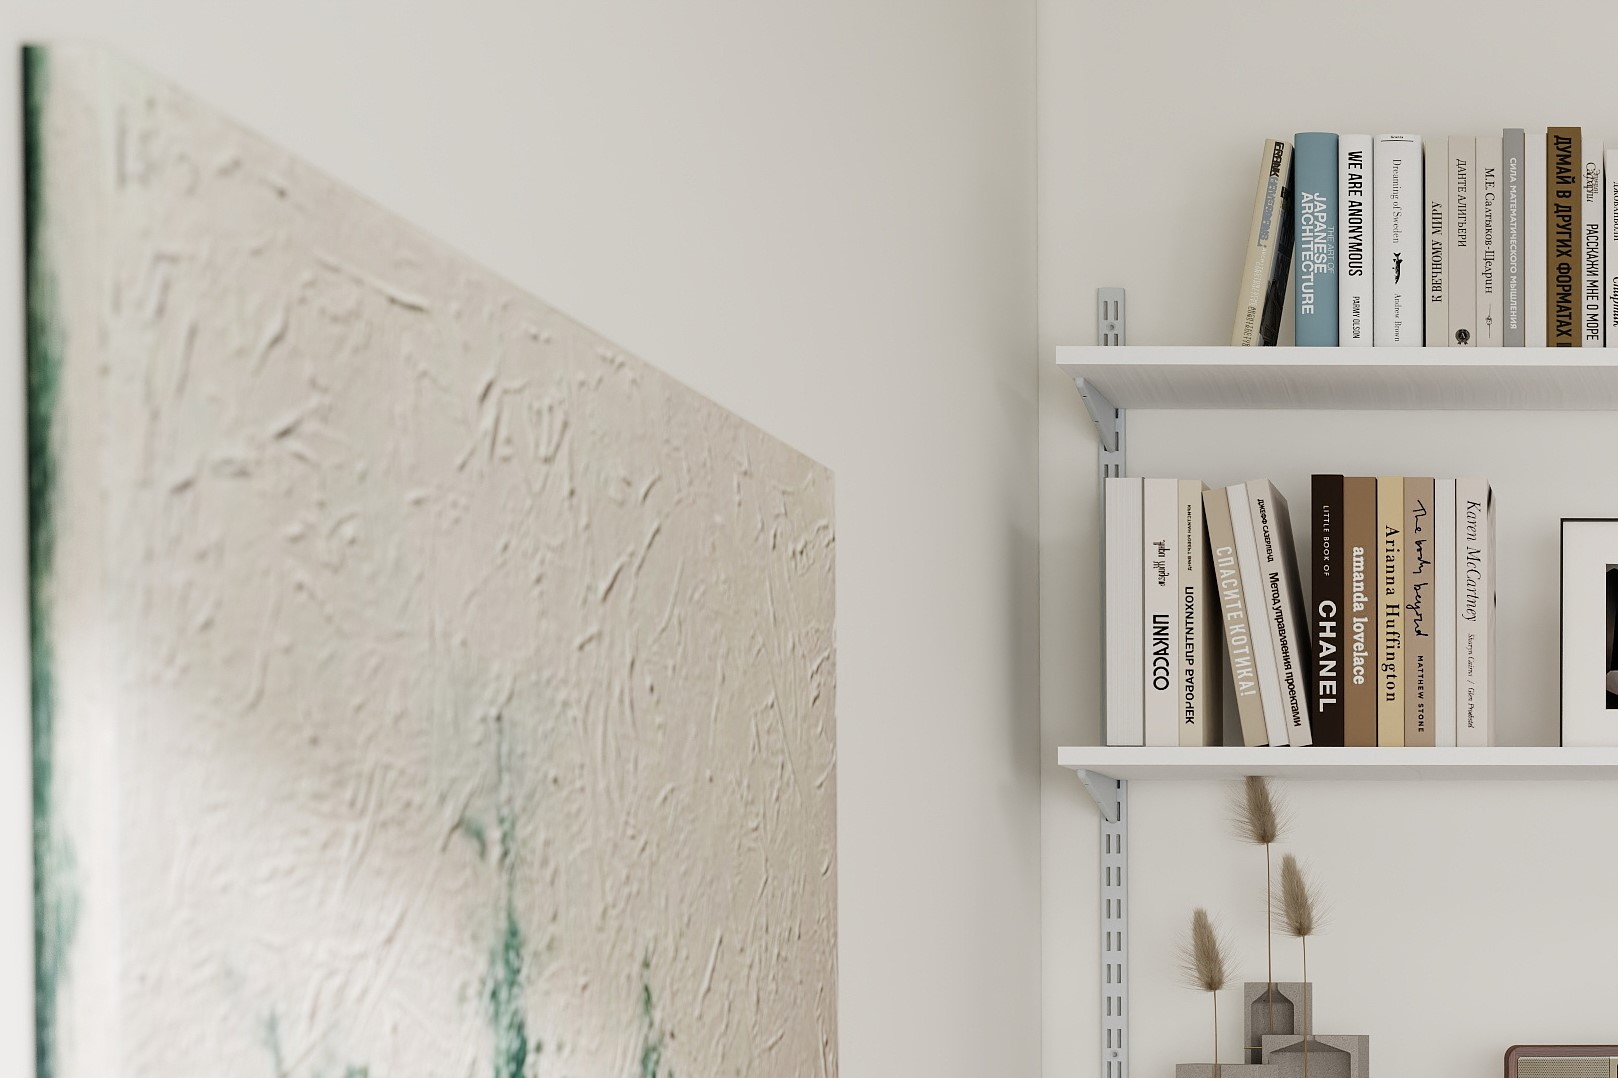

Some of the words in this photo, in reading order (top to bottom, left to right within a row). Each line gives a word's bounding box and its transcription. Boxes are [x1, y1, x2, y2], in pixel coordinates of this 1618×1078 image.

[1348, 151, 1362, 169] WE
[1348, 174, 1362, 196] ARE
[1391, 159, 1402, 199] Dreaming
[1456, 159, 1467, 192] ДАНТЕ
[1485, 168, 1494, 190] М.Е.
[1554, 135, 1575, 185] ДУМАЙ
[1393, 202, 1402, 210] of
[1432, 201, 1442, 235] МИРУ
[1556, 190, 1571, 198] В
[1314, 192, 1326, 274] JAPANESE
[1348, 201, 1362, 277] ANONYMOUS
[1393, 211, 1402, 243] Sweden
[1457, 194, 1467, 247] АЛИГЬЕРИ
[1482, 192, 1495, 293] Салтыков-Щедрин
[1554, 204, 1571, 258] ДРУГИХ
[1301, 192, 1314, 314] ARCHITECTURE
[1328, 264, 1335, 274] OF
[1432, 240, 1442, 292] ВЕЧНОМУ
[1587, 224, 1598, 276] РАССКАЖИ
[1394, 293, 1402, 319] Andrew
[1556, 263, 1572, 337] ФОРМАТАХ
[1587, 280, 1598, 300] МНЕ
[1394, 321, 1402, 341] Brown
[1587, 314, 1598, 340] МОРЕ
[1257, 499, 1268, 524] ДЖЕФФ
[1263, 525, 1274, 562] САЗЕРЛЕНД
[1413, 500, 1426, 533] The
[1467, 500, 1481, 541] Karen
[1324, 565, 1329, 576] OF
[1353, 547, 1368, 612] amanda
[1385, 526, 1400, 596] Arianna
[1462, 546, 1482, 622] McCartney
[1216, 547, 1244, 621] СПАСИТЕ
[1230, 624, 1256, 697] КОТИКА!
[1406, 583, 1428, 637] beyond
[1269, 572, 1282, 606] Метод
[1286, 672, 1302, 727] проектами
[1318, 600, 1337, 712] CHANEL
[1353, 617, 1368, 685] lovelace
[1381, 604, 1400, 701] Huffington
